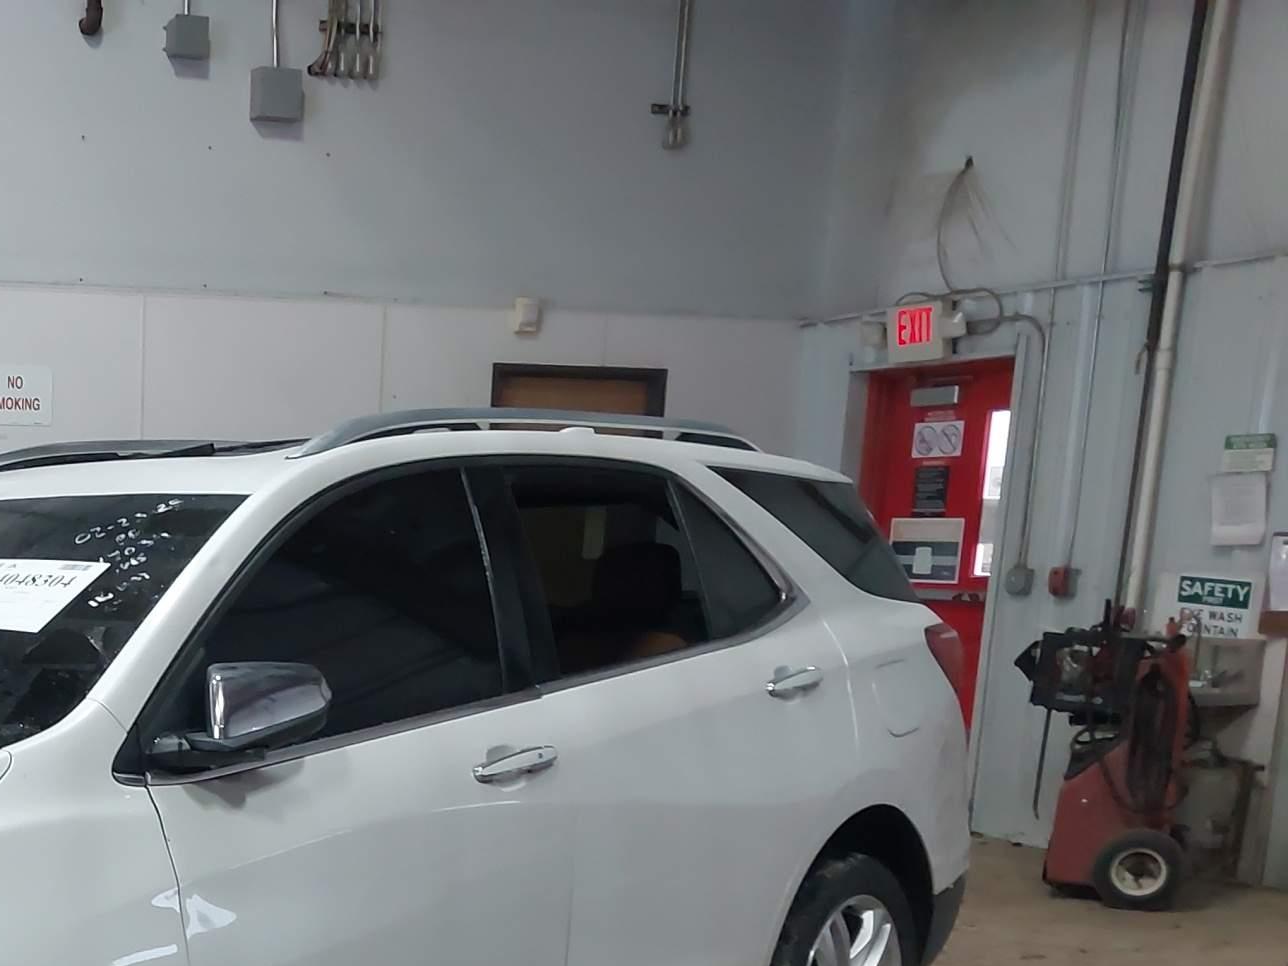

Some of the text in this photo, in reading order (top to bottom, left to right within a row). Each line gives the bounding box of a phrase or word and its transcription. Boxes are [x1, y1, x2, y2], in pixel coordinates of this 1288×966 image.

[898, 307, 932, 345] EXIT
[7, 375, 24, 389] NO
[1179, 580, 1250, 602] SAFETY
[1208, 611, 1244, 623] WASH
